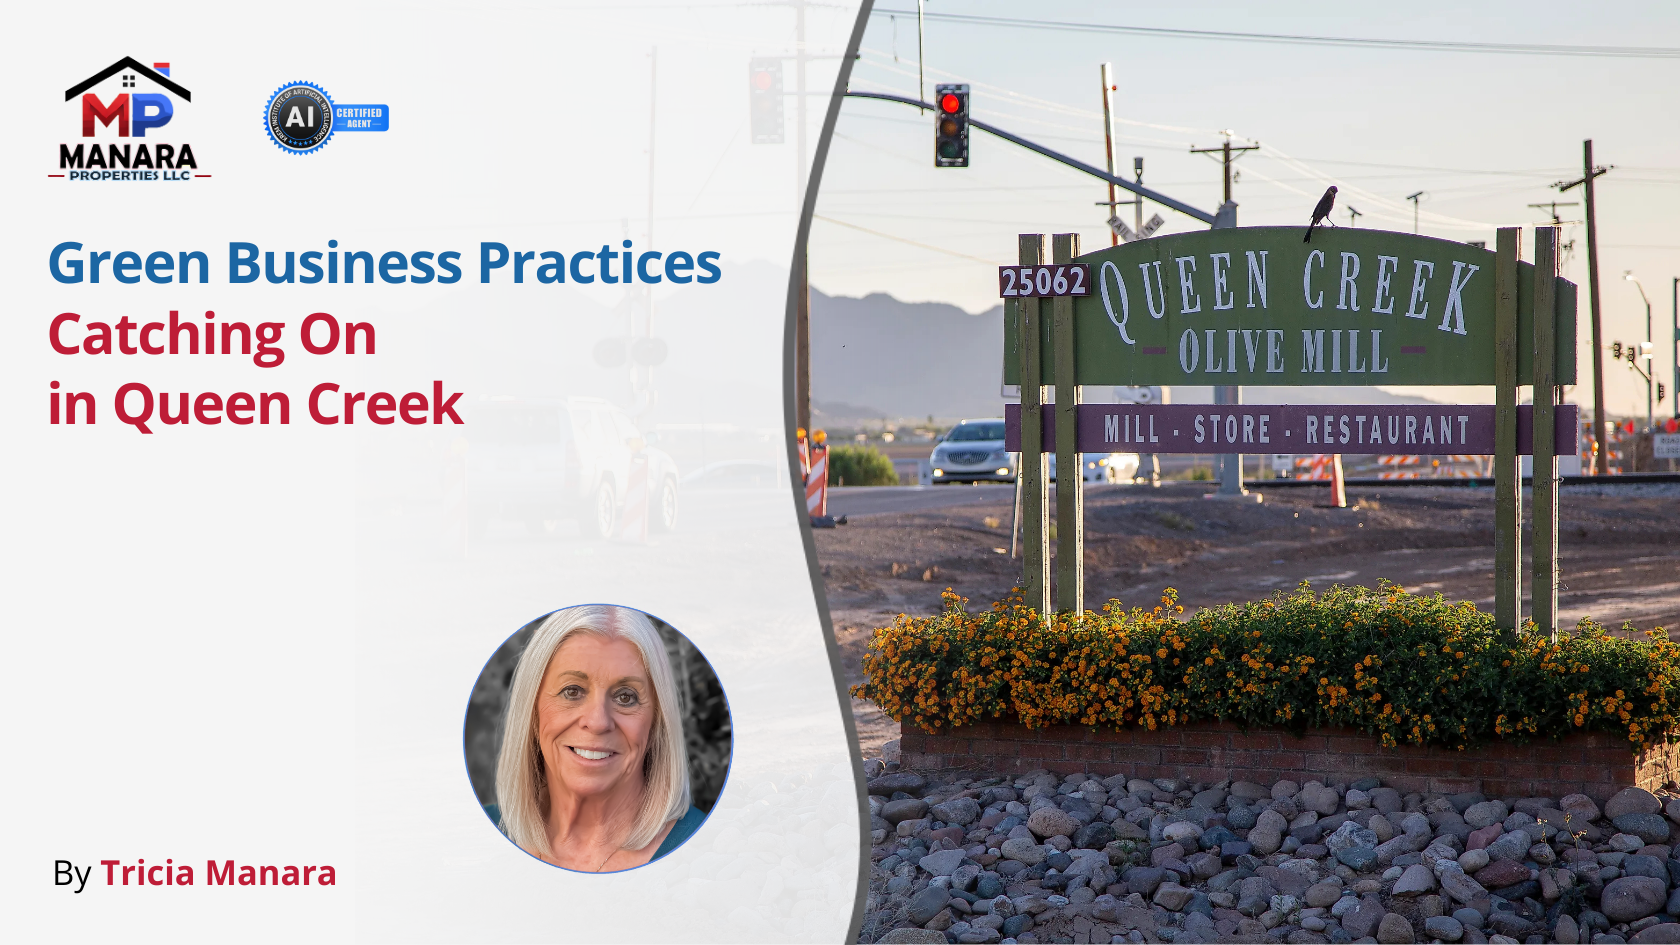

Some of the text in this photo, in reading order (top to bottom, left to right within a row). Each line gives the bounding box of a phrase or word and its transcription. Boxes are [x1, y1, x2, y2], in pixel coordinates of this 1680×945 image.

[1002, 266, 1086, 296] 25062
[1100, 249, 1480, 345] QUEEN CREEK
[1179, 329, 1389, 374] OLIVE MILL
[1104, 414, 1469, 445] MILL STORE RESTAURANT
